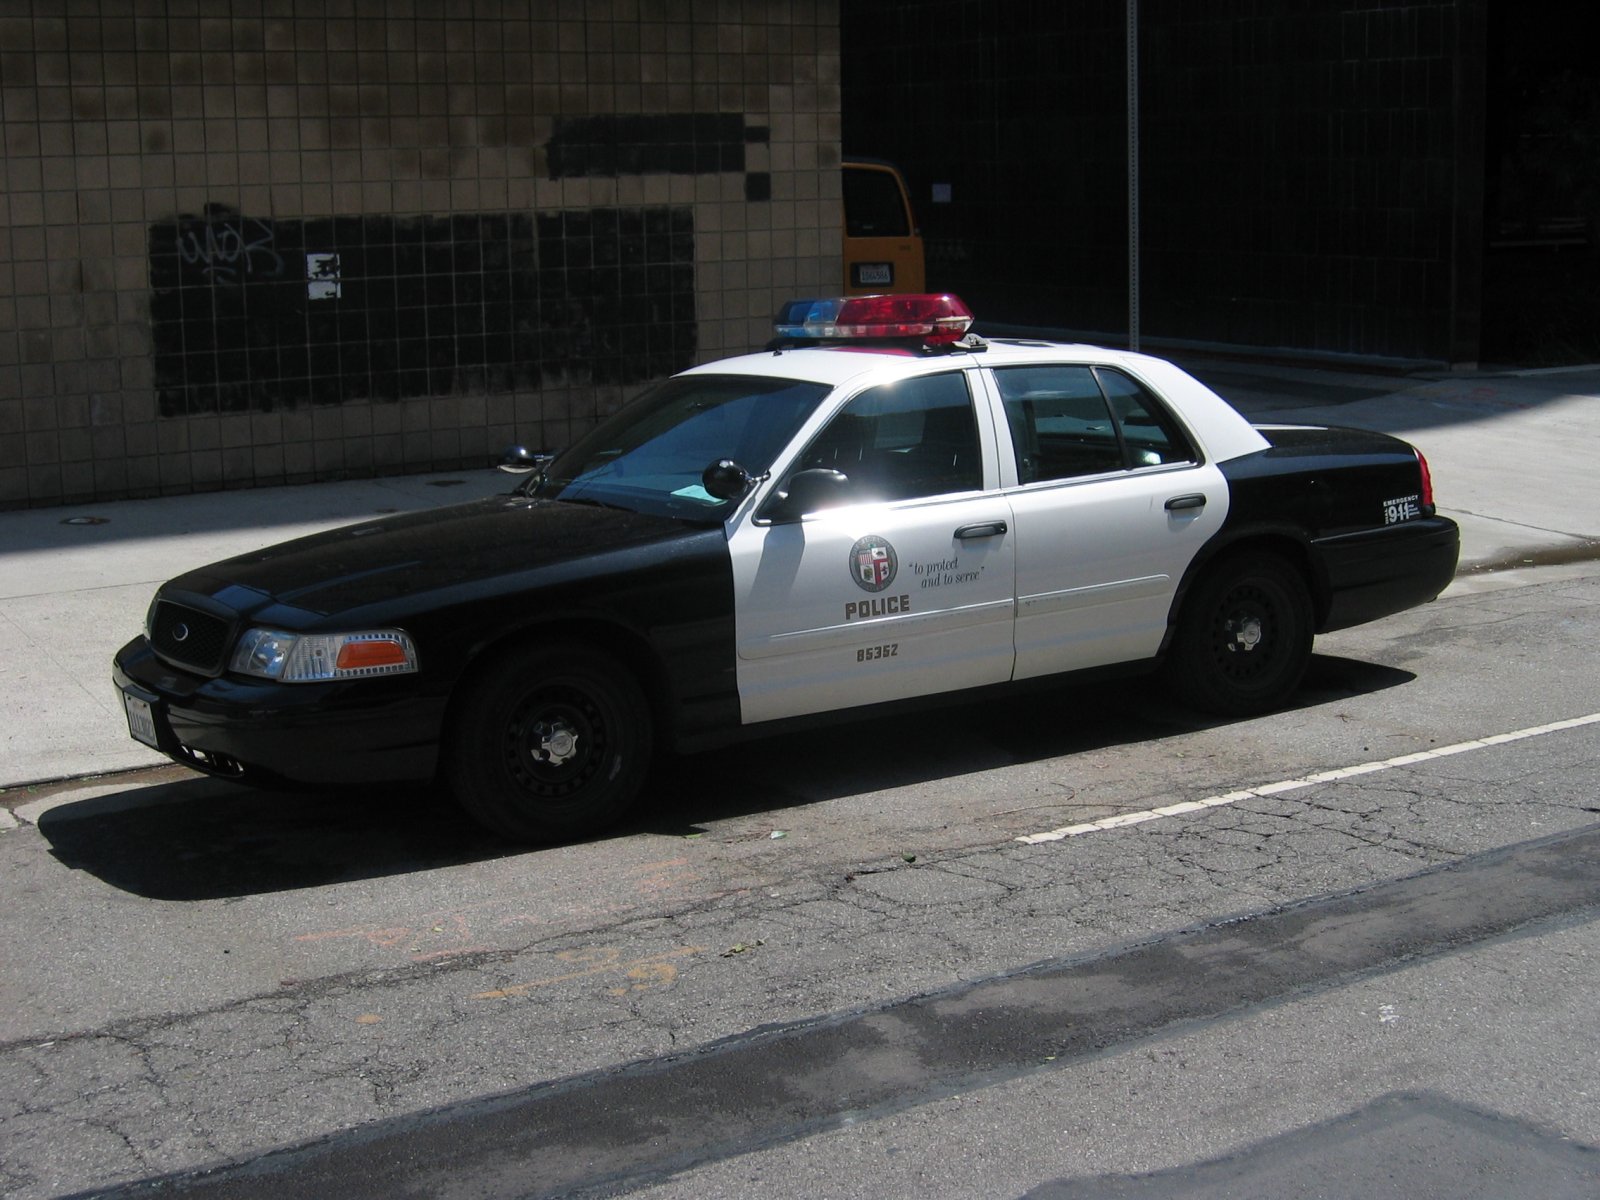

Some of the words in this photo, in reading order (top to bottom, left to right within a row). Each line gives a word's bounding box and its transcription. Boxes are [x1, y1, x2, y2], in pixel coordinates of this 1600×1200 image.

[926, 557, 959, 575] protect
[921, 574, 941, 589] and
[943, 572, 953, 585] to
[845, 594, 910, 620] POLICE
